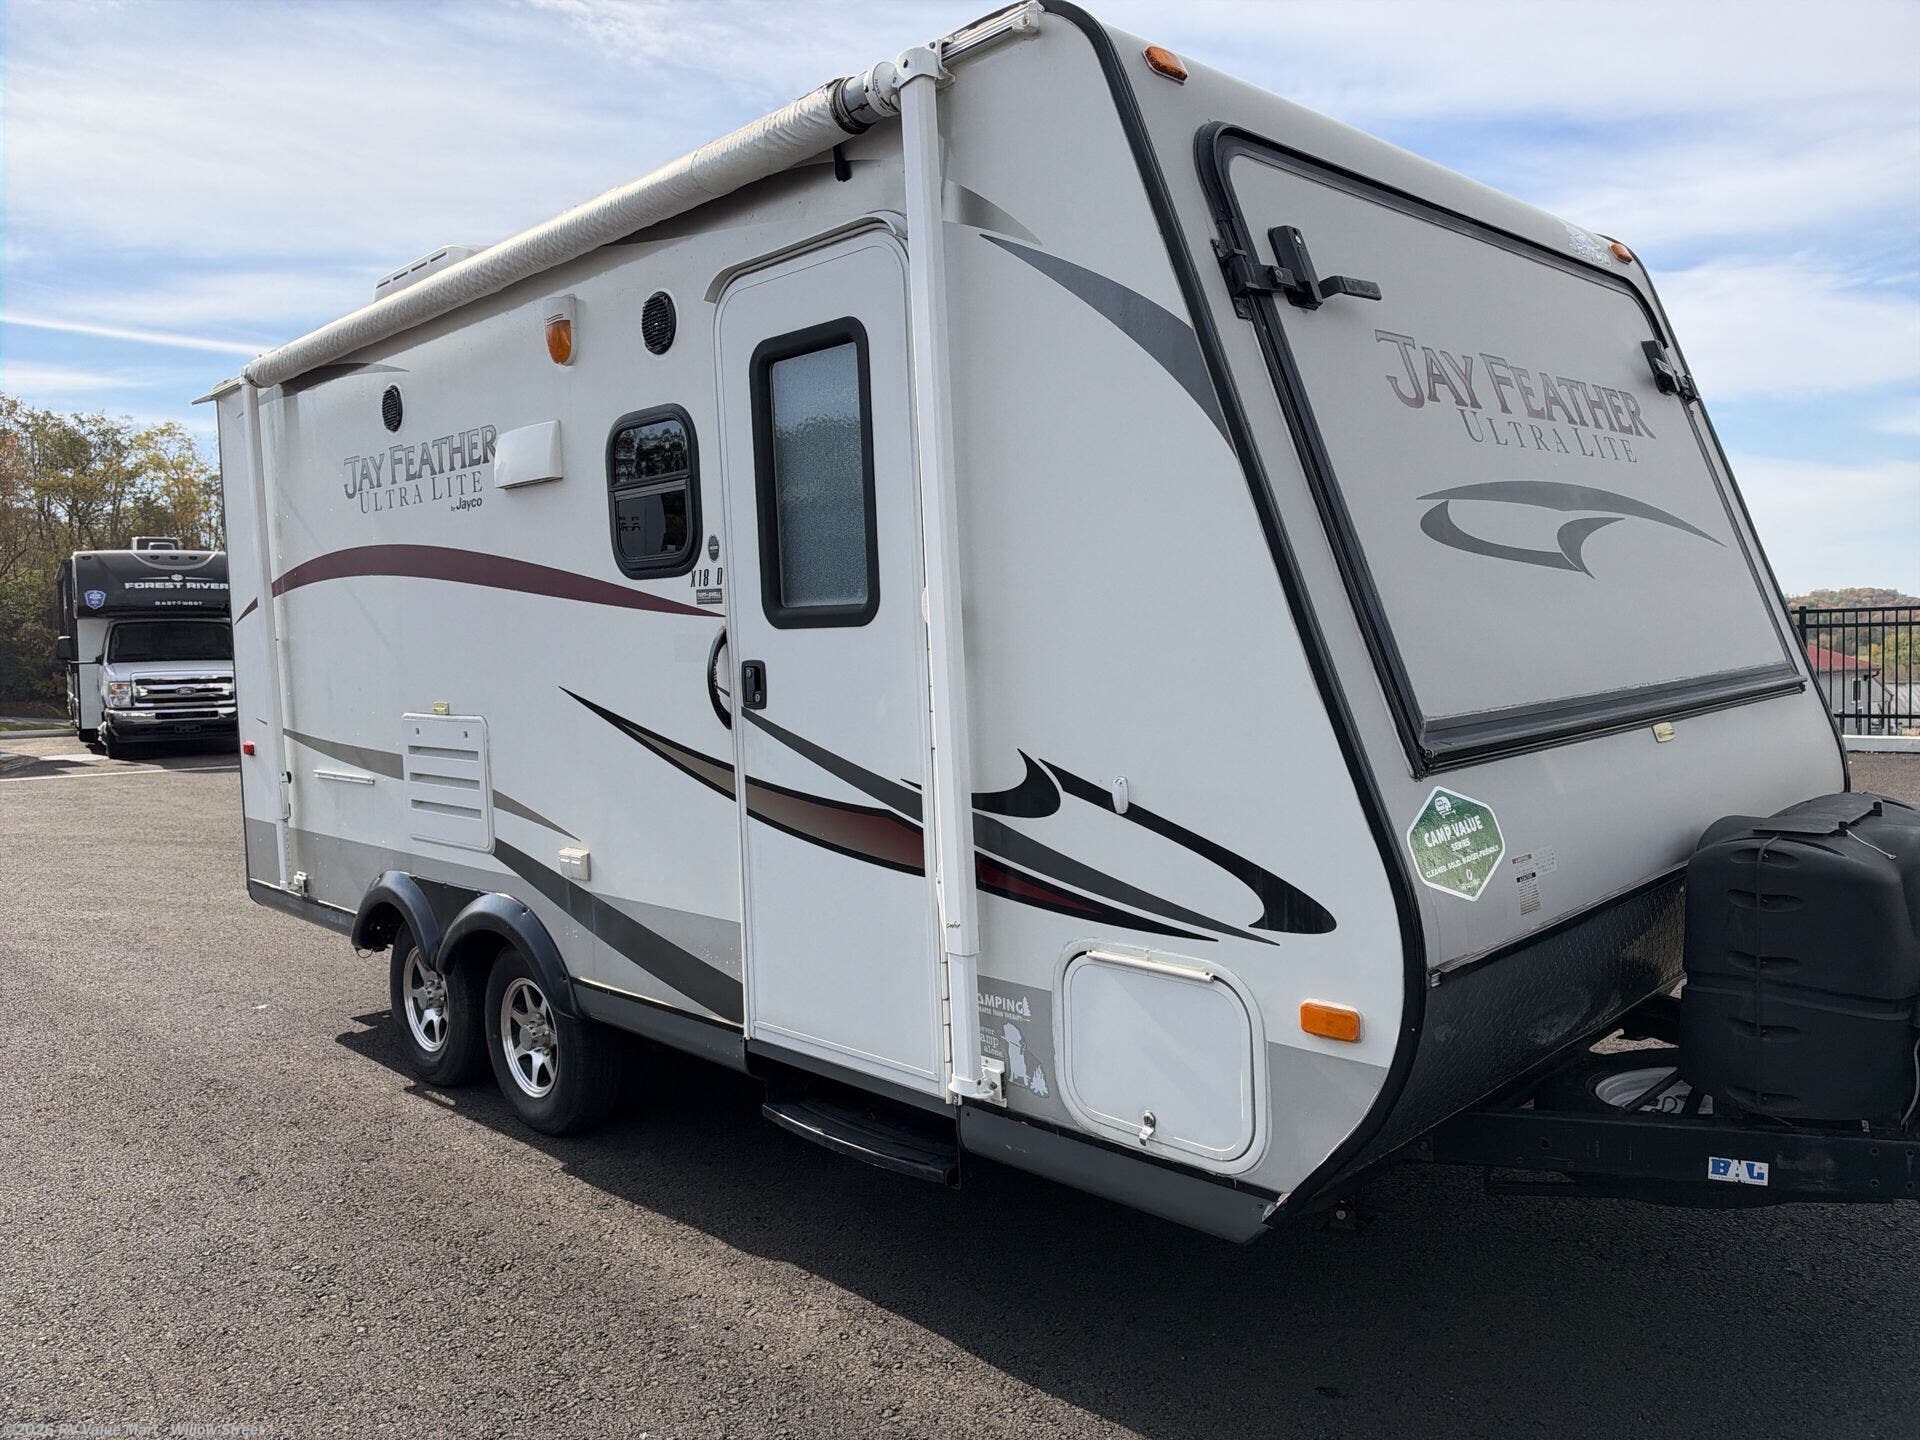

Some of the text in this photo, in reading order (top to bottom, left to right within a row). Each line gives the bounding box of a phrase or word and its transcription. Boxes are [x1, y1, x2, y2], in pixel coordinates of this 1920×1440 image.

[1374, 328, 1657, 440] JAY FEATHER
[1456, 408, 1638, 463] ULTRA LITE
[343, 424, 497, 500] JAY FEATHER
[357, 470, 484, 514] ULTRA LITE
[455, 496, 483, 512] Jayco
[124, 582, 229, 590] FOREST RIVER
[690, 568, 710, 588] X18
[1424, 815, 1484, 848] CAMP VALUE
[1450, 838, 1471, 852] SERIES
[977, 993, 1023, 1014] AMPING
[980, 1033, 999, 1048] amp
